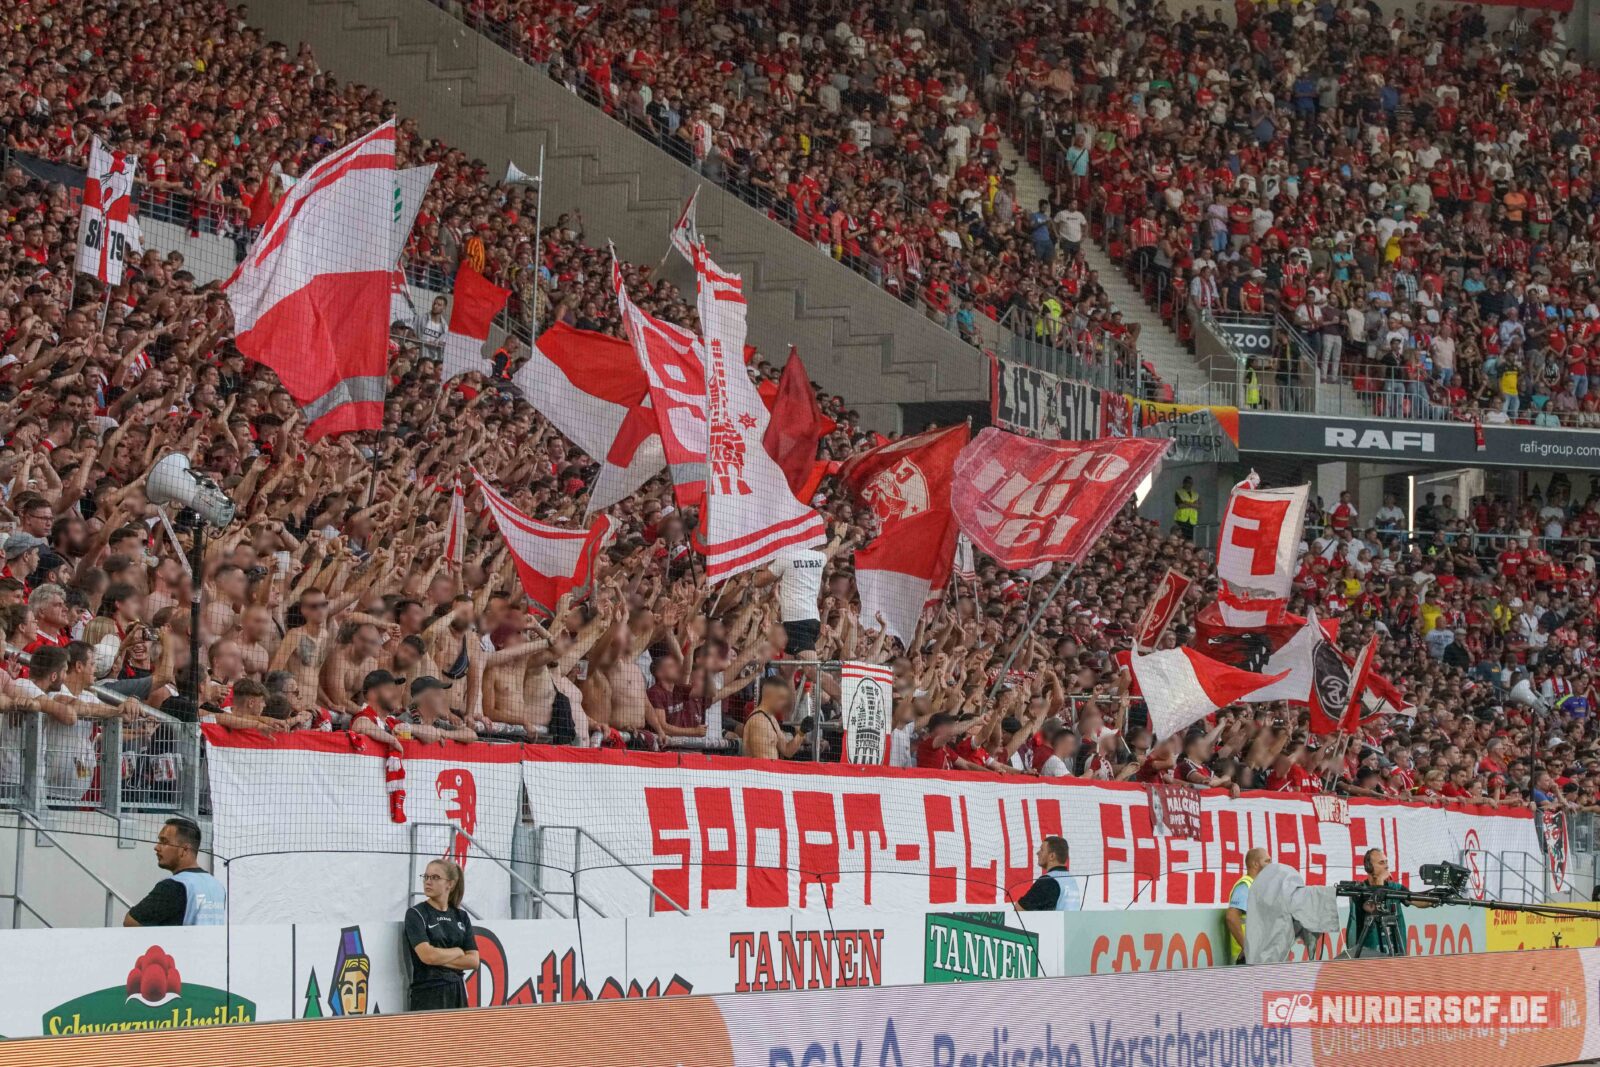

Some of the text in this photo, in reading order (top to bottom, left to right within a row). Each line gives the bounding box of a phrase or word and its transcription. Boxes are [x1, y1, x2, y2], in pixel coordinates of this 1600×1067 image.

[109, 230, 125, 261] 79
[1231, 332, 1271, 349] ZOO
[998, 359, 1100, 441] LIST SYLT
[1146, 403, 1208, 426] Badner
[1325, 427, 1435, 452] RAFI
[1520, 440, 1600, 457] rafi-group.com
[930, 923, 1034, 979] TANNEN
[1407, 923, 1473, 956] AZOO
[729, 929, 885, 993] TANNEN
